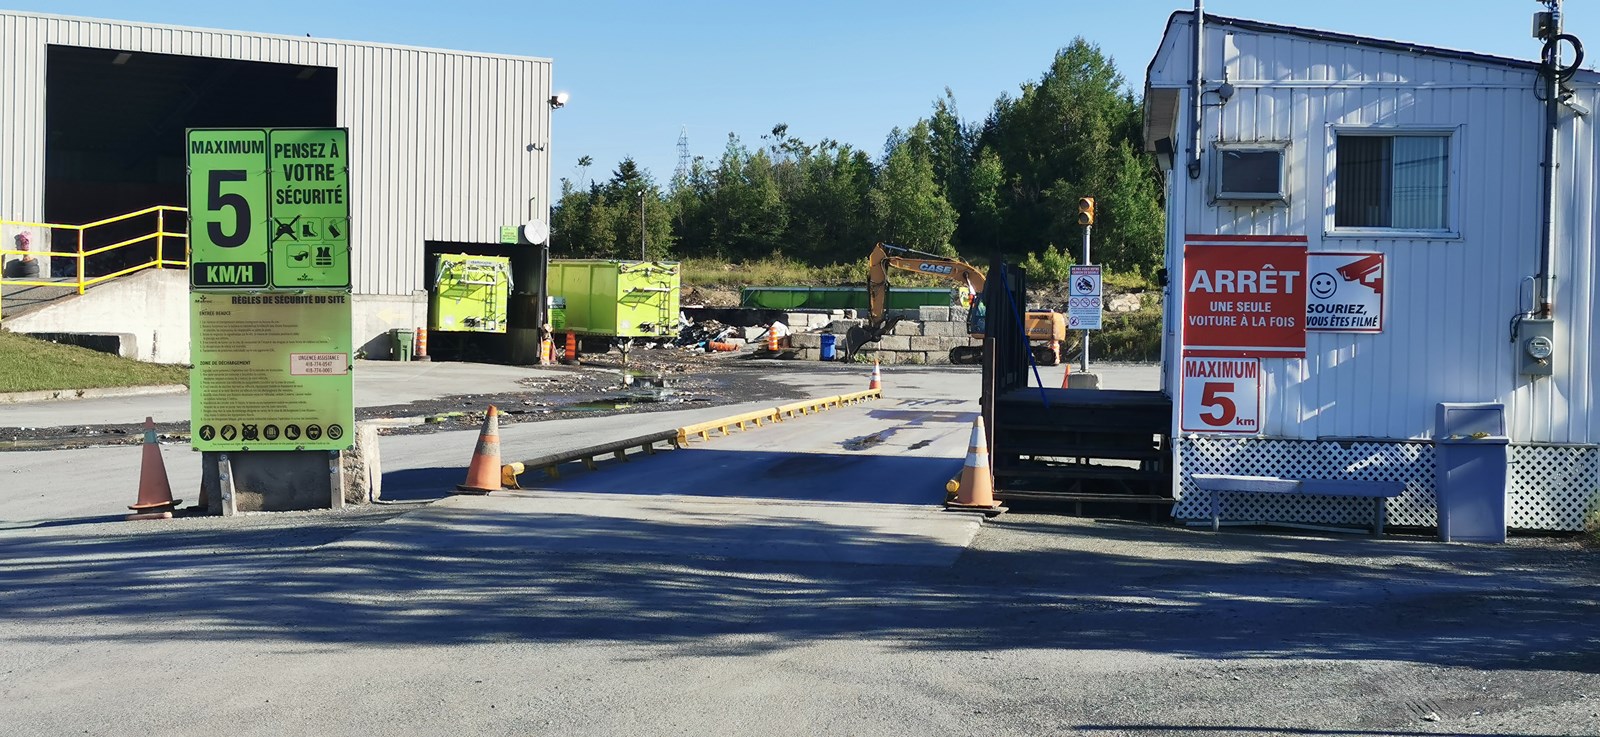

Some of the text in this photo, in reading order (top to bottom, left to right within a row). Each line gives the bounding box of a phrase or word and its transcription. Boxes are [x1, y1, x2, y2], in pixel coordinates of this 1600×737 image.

[191, 140, 264, 154] MAXIMUM
[274, 138, 339, 159] PENSEZ À
[283, 163, 335, 181] VOTRE
[276, 184, 343, 205] SÉCURITÉ
[206, 169, 251, 248] 5
[207, 265, 253, 284] KM/H
[919, 263, 952, 274] CASE
[1188, 263, 1300, 294] ARRÊT
[231, 295, 345, 305] RÈGLES DE SÉCURITÉ DU SITE
[1209, 301, 1271, 313] UNE SEULE
[1307, 304, 1367, 316] SOURIEZ,
[1189, 313, 1295, 327] VOITURE À LA FOIS
[1306, 314, 1379, 327] VOUS ÊTES FILMÉ
[1185, 361, 1256, 378] MAXIMUM
[1199, 382, 1255, 426] 5 km
